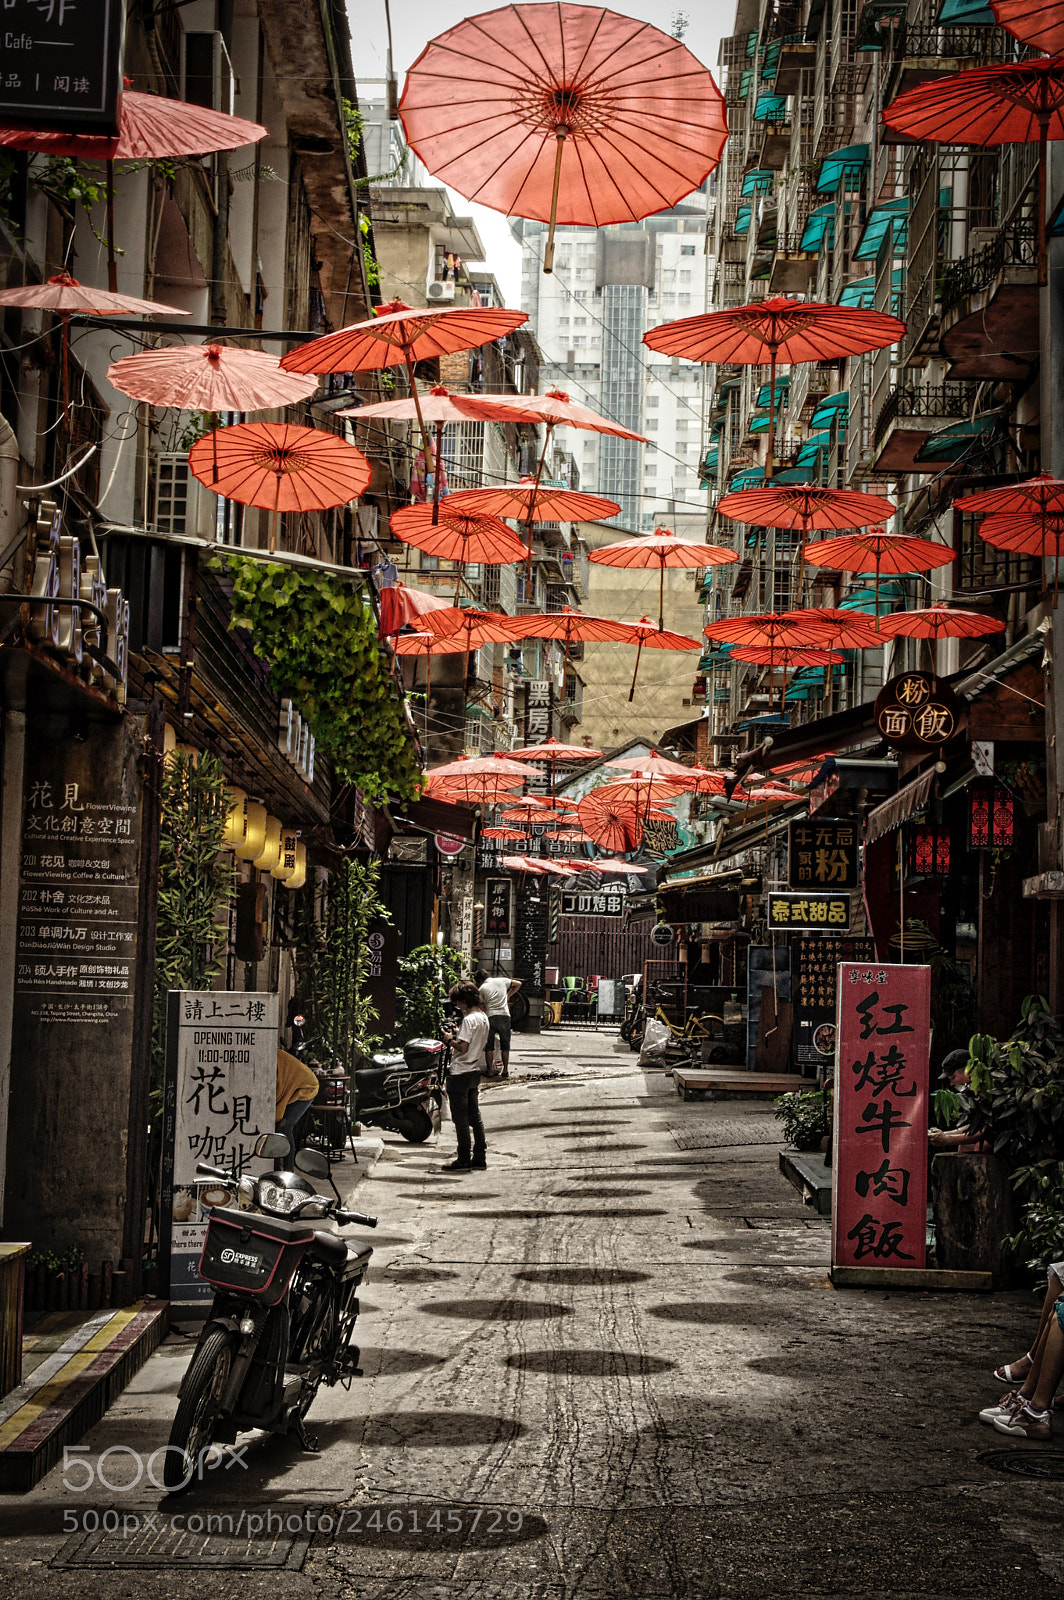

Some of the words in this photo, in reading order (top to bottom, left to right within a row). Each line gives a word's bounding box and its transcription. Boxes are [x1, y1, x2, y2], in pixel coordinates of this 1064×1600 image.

[54, 75, 90, 93] 阅读
[899, 678, 930, 705] 粉
[27, 814, 132, 835] 文化創意空間
[815, 849, 850, 882] 粉
[772, 901, 847, 923] 泰式甜品
[184, 999, 266, 1022] 請上二樓
[194, 1031, 233, 1046] OPENING
[235, 1032, 256, 1046] TIME
